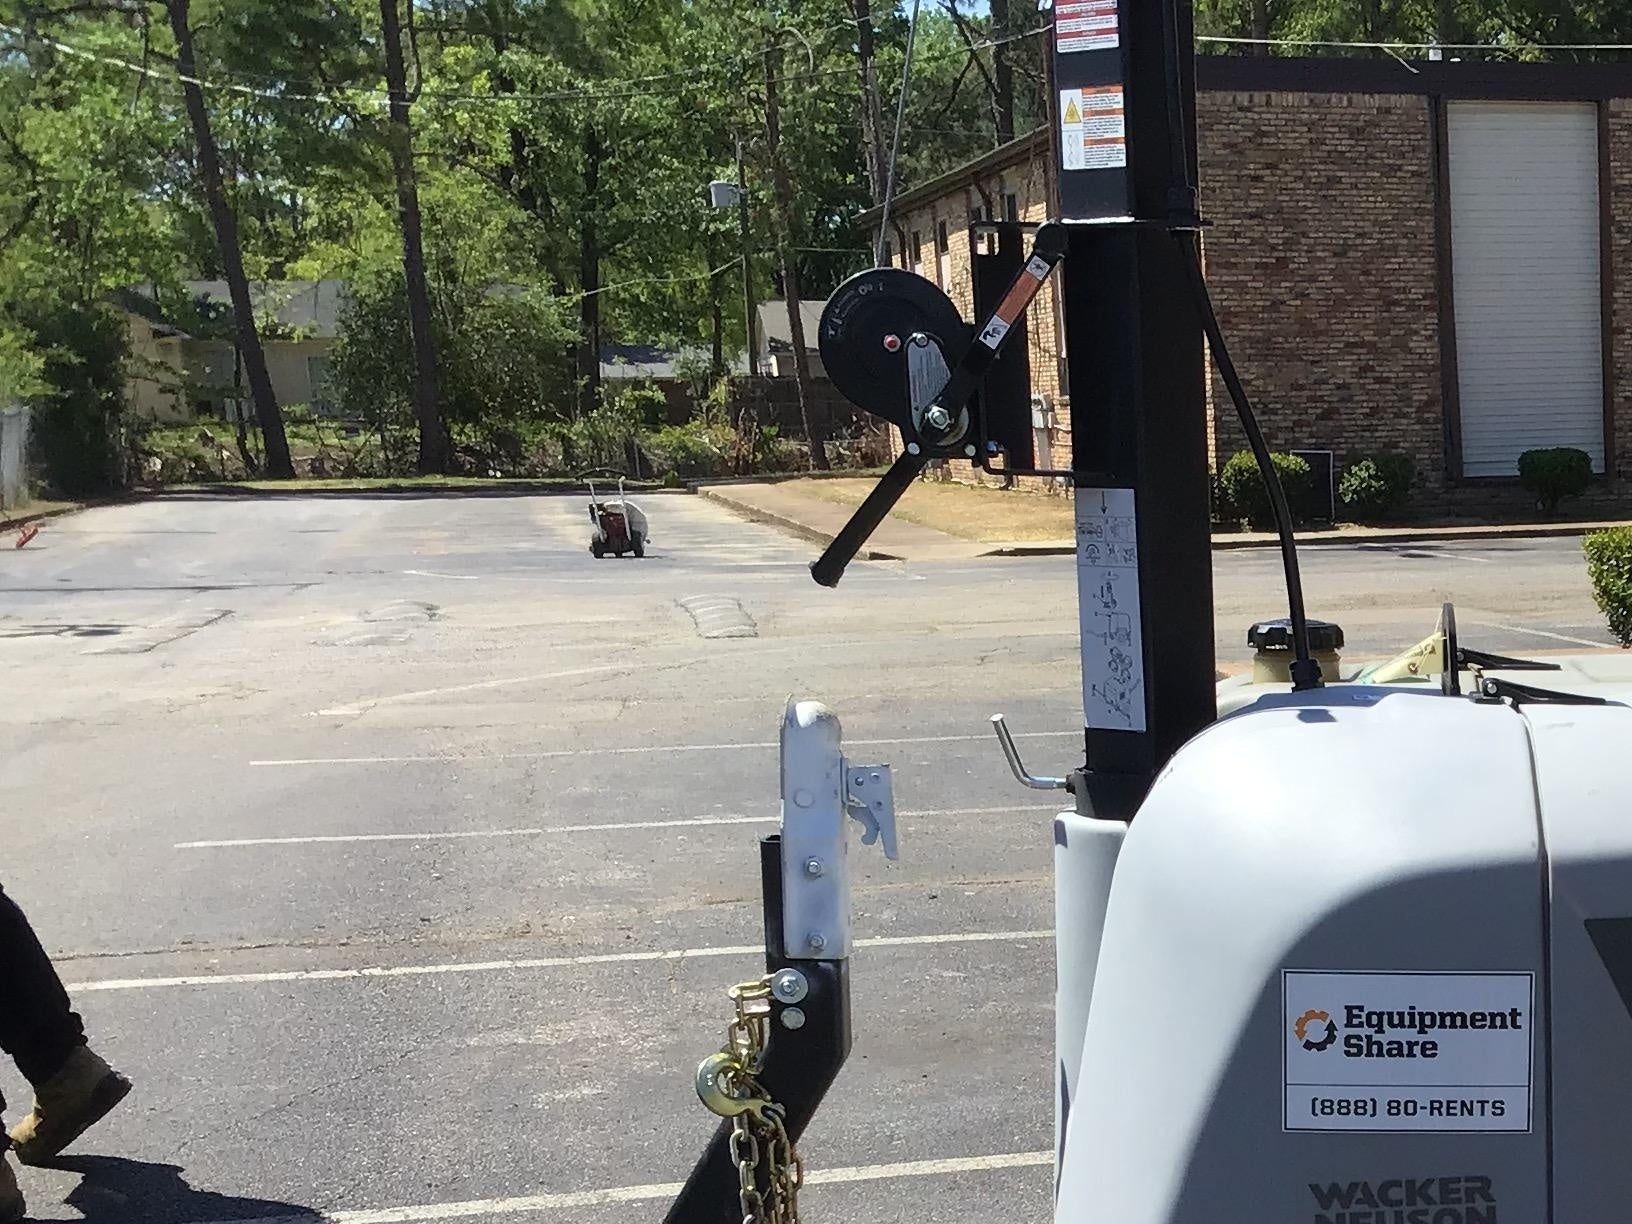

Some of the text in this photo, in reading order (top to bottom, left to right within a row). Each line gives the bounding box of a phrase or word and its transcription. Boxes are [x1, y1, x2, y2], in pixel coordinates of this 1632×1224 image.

[1344, 1005, 1522, 1035] Equipment
[1344, 1034, 1438, 1059] Share
[1311, 1098, 1506, 1118] (888) 80-RENTS
[1308, 1175, 1496, 1209] WACKER
